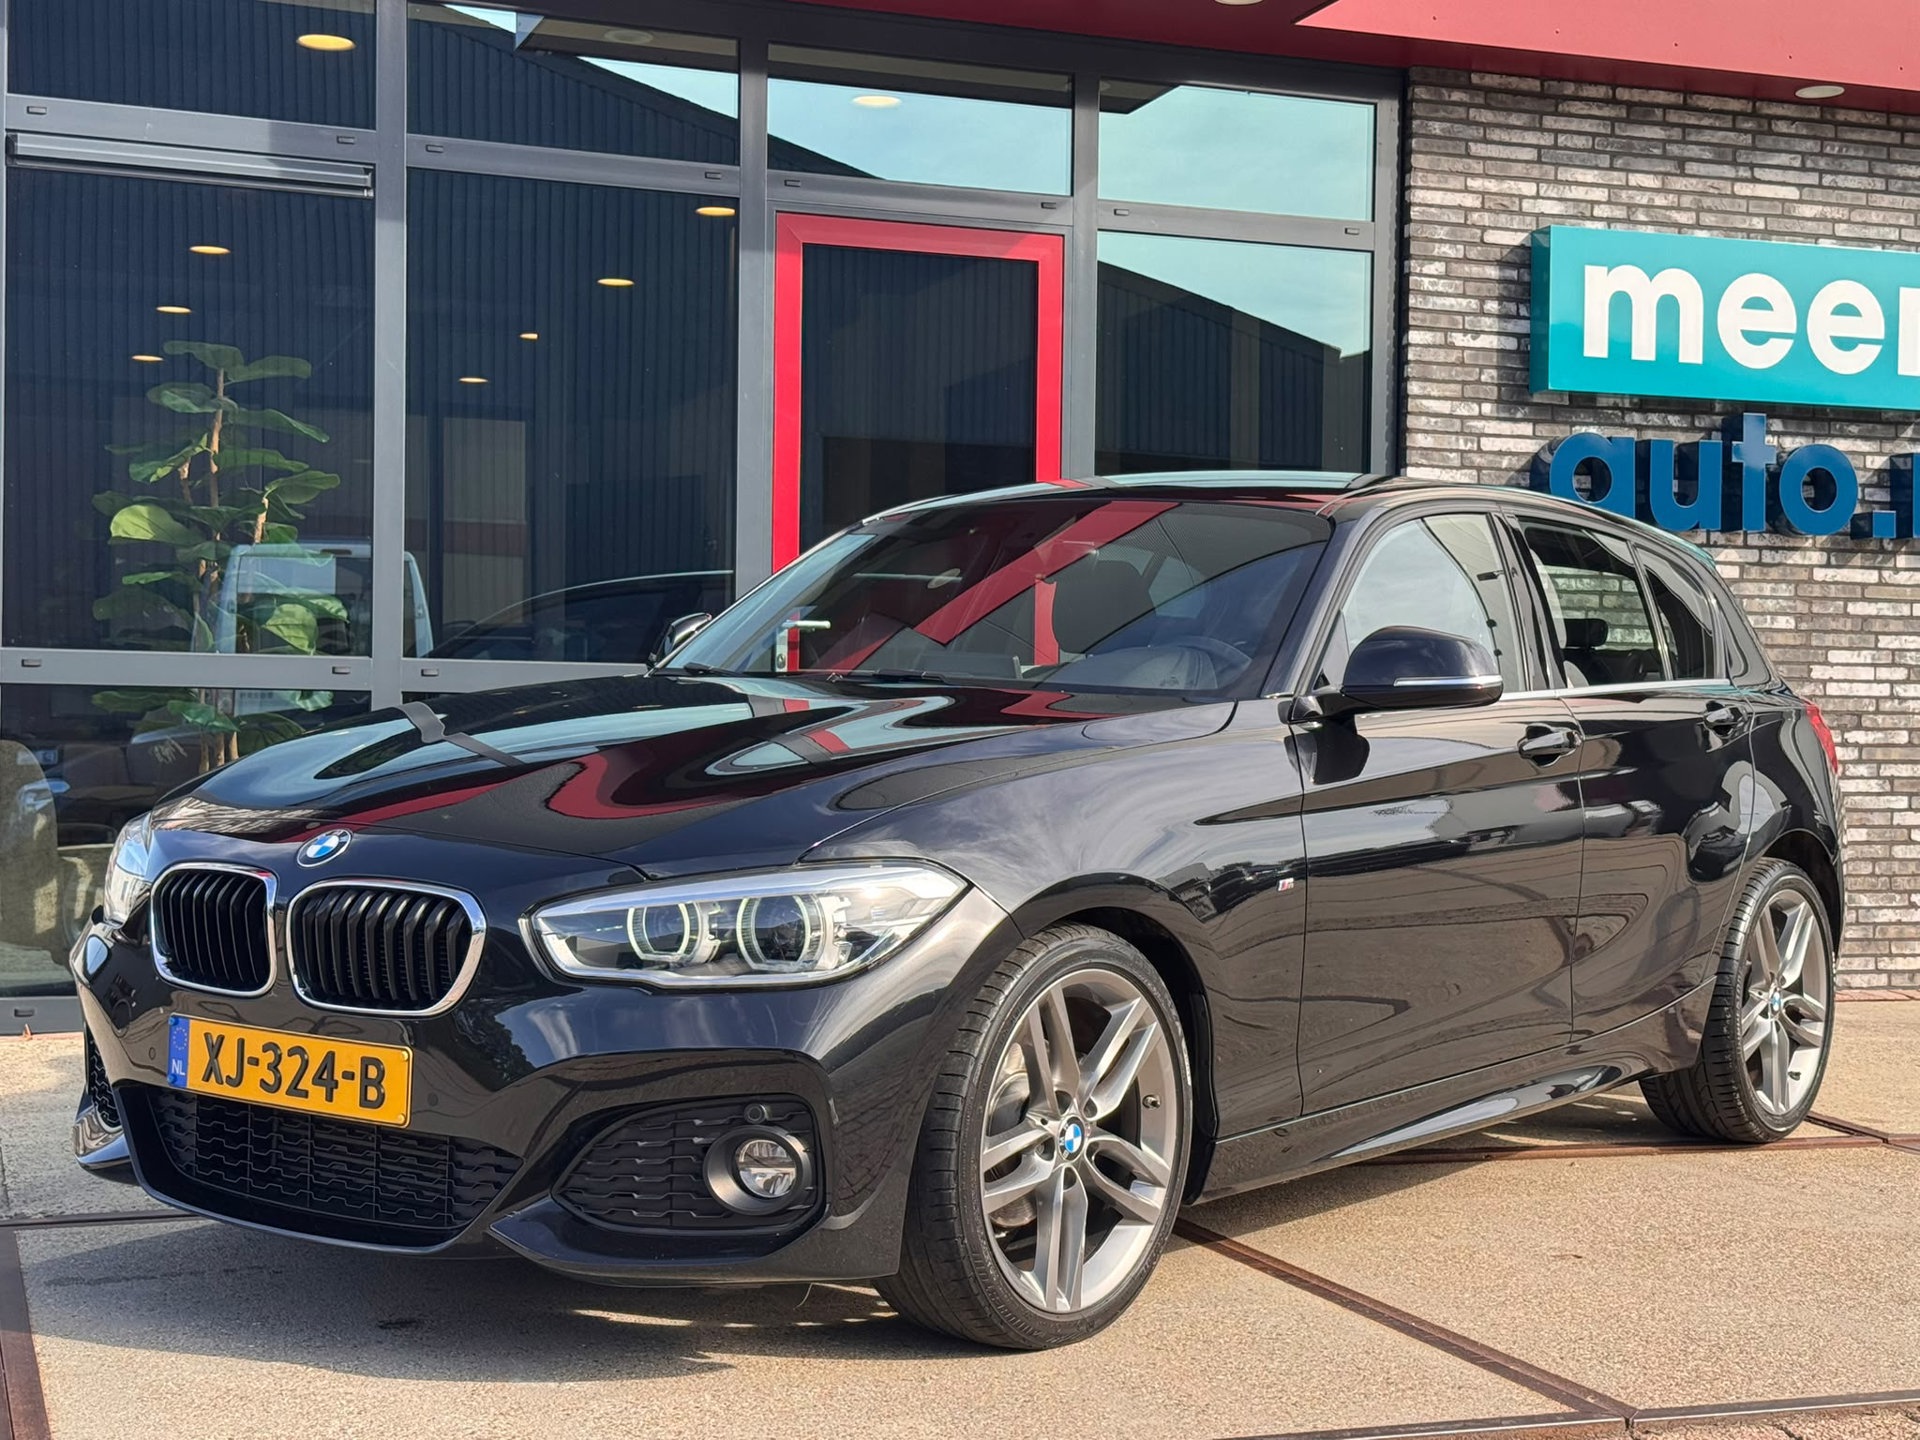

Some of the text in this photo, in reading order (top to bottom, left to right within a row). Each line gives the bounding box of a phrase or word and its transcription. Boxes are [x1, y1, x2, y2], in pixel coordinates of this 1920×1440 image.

[1549, 412, 1920, 537] auto.
[171, 1032, 386, 1110] NL XJ-324-B
